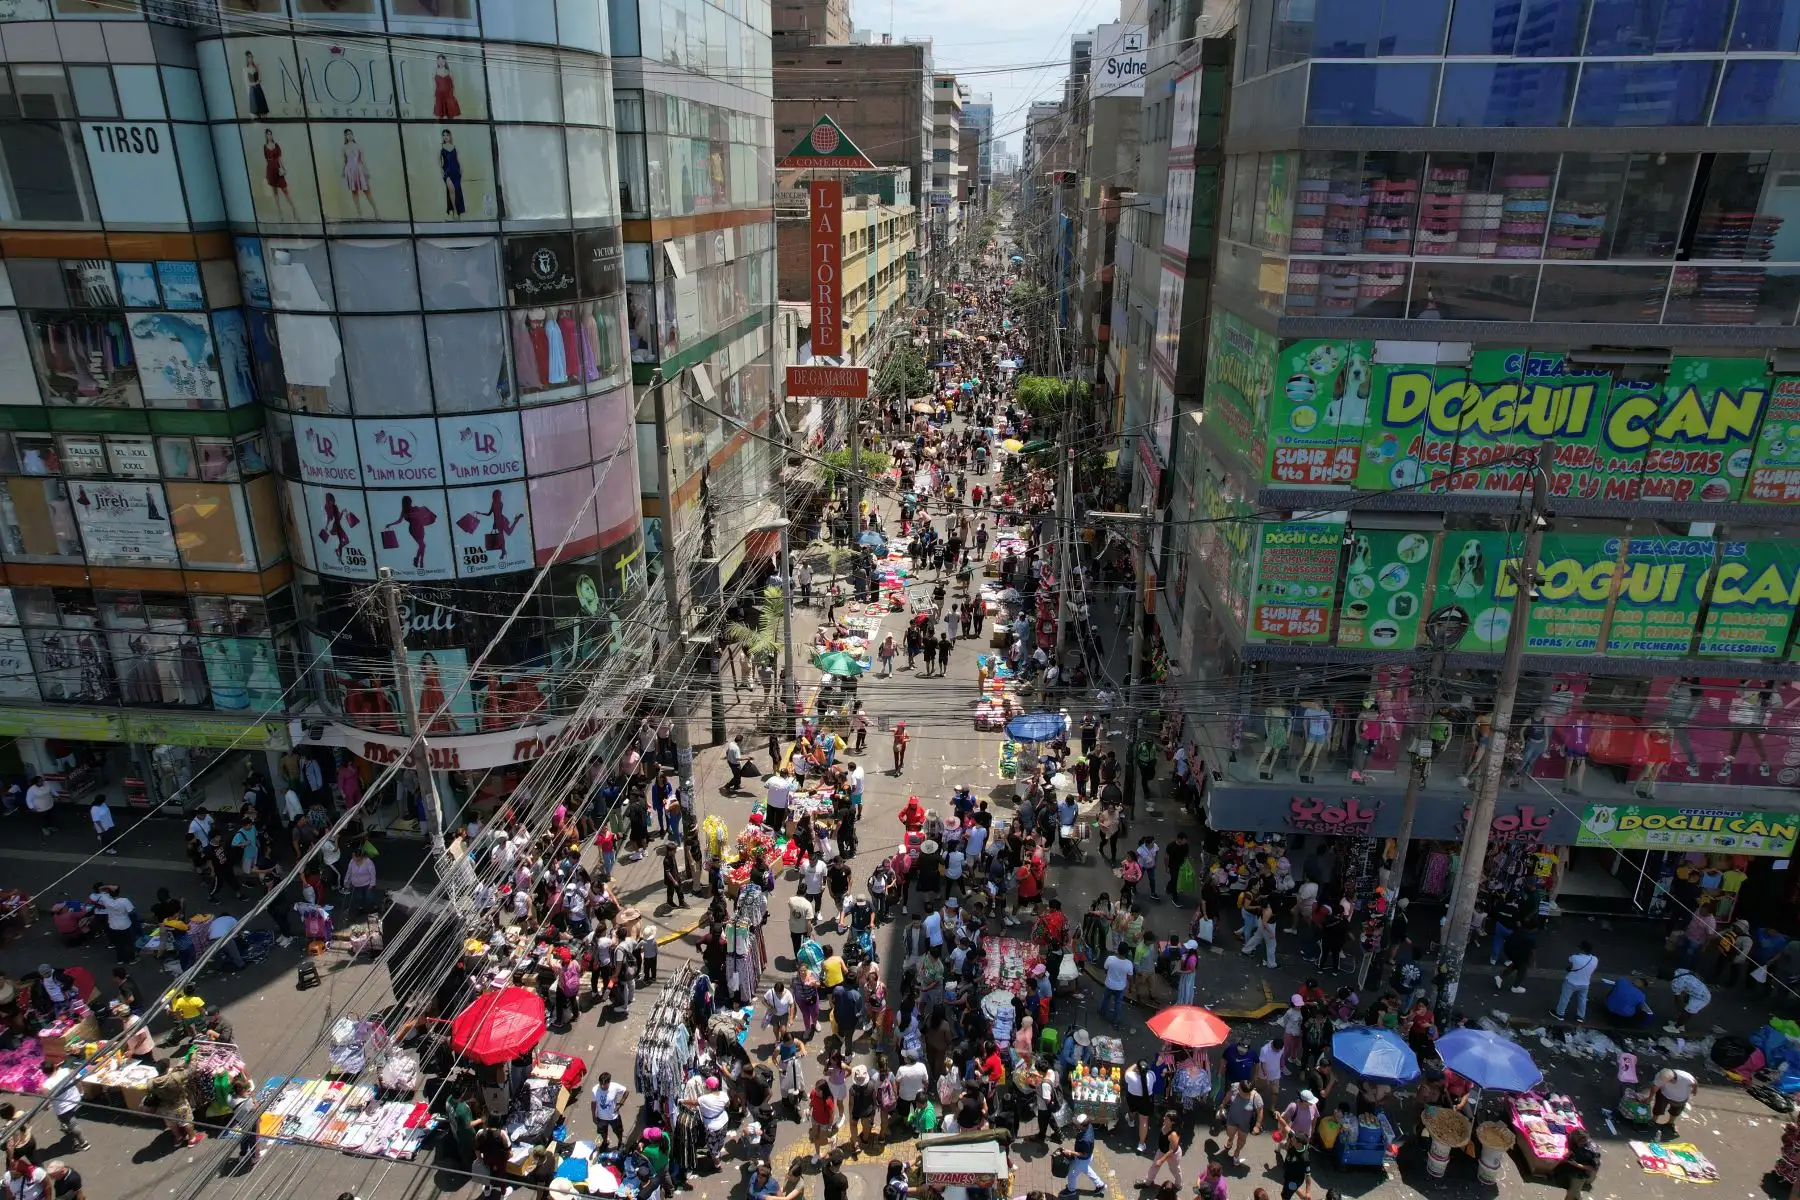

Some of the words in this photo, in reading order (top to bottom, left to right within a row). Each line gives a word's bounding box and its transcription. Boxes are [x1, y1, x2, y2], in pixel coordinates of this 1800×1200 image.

[92, 125, 160, 155] TIRSO
[796, 158, 867, 168] COMERCIAL
[817, 188, 834, 233] LA
[816, 243, 834, 346] TORRE
[794, 369, 808, 385] DE
[809, 370, 860, 387] GAMARRA
[1382, 369, 1599, 438] DOGUI
[1603, 383, 1768, 453] CAN
[68, 447, 100, 455] TALLAS
[387, 434, 413, 459] LR
[474, 431, 498, 454] LR
[1275, 448, 1328, 466] SUBIR
[1335, 447, 1358, 464] AL
[1408, 435, 1543, 470] ACCESORIOS
[1607, 448, 1724, 476] MASCOTAS
[122, 462, 144, 470] XXXL
[307, 465, 324, 477] LIAM
[323, 466, 357, 481] ROUSE
[372, 466, 396, 481] LIAM
[398, 467, 437, 481] ROUSE
[456, 464, 481, 479] LIAM
[483, 460, 520, 476] ROUSE
[1277, 465, 1305, 481] 4to
[1309, 464, 1353, 482] PISO
[1430, 469, 1481, 494] POR
[1485, 471, 1572, 497] MAYR
[1603, 477, 1695, 502] MENOR
[95, 493, 130, 511] Jireh
[1265, 533, 1307, 545] DOGUI
[1309, 533, 1339, 545] CAN
[1604, 538, 1747, 558] CREACIONES
[346, 555, 367, 567] 309
[463, 553, 489, 566] 309
[1260, 606, 1302, 621] SUBIR
[1305, 608, 1323, 622] AL
[1719, 612, 1788, 627] MASCOTA
[1261, 619, 1285, 632] 3er
[1288, 620, 1320, 634] PISO
[1716, 627, 1768, 641] MENOR
[1529, 637, 1564, 648] ROPAS
[1632, 640, 1688, 651] PECHERAS
[1709, 642, 1777, 653] ACCESORIOS
[1616, 814, 1724, 832] DOGUI
[1729, 818, 1798, 840] CAN
[928, 1173, 975, 1184] JUANES
